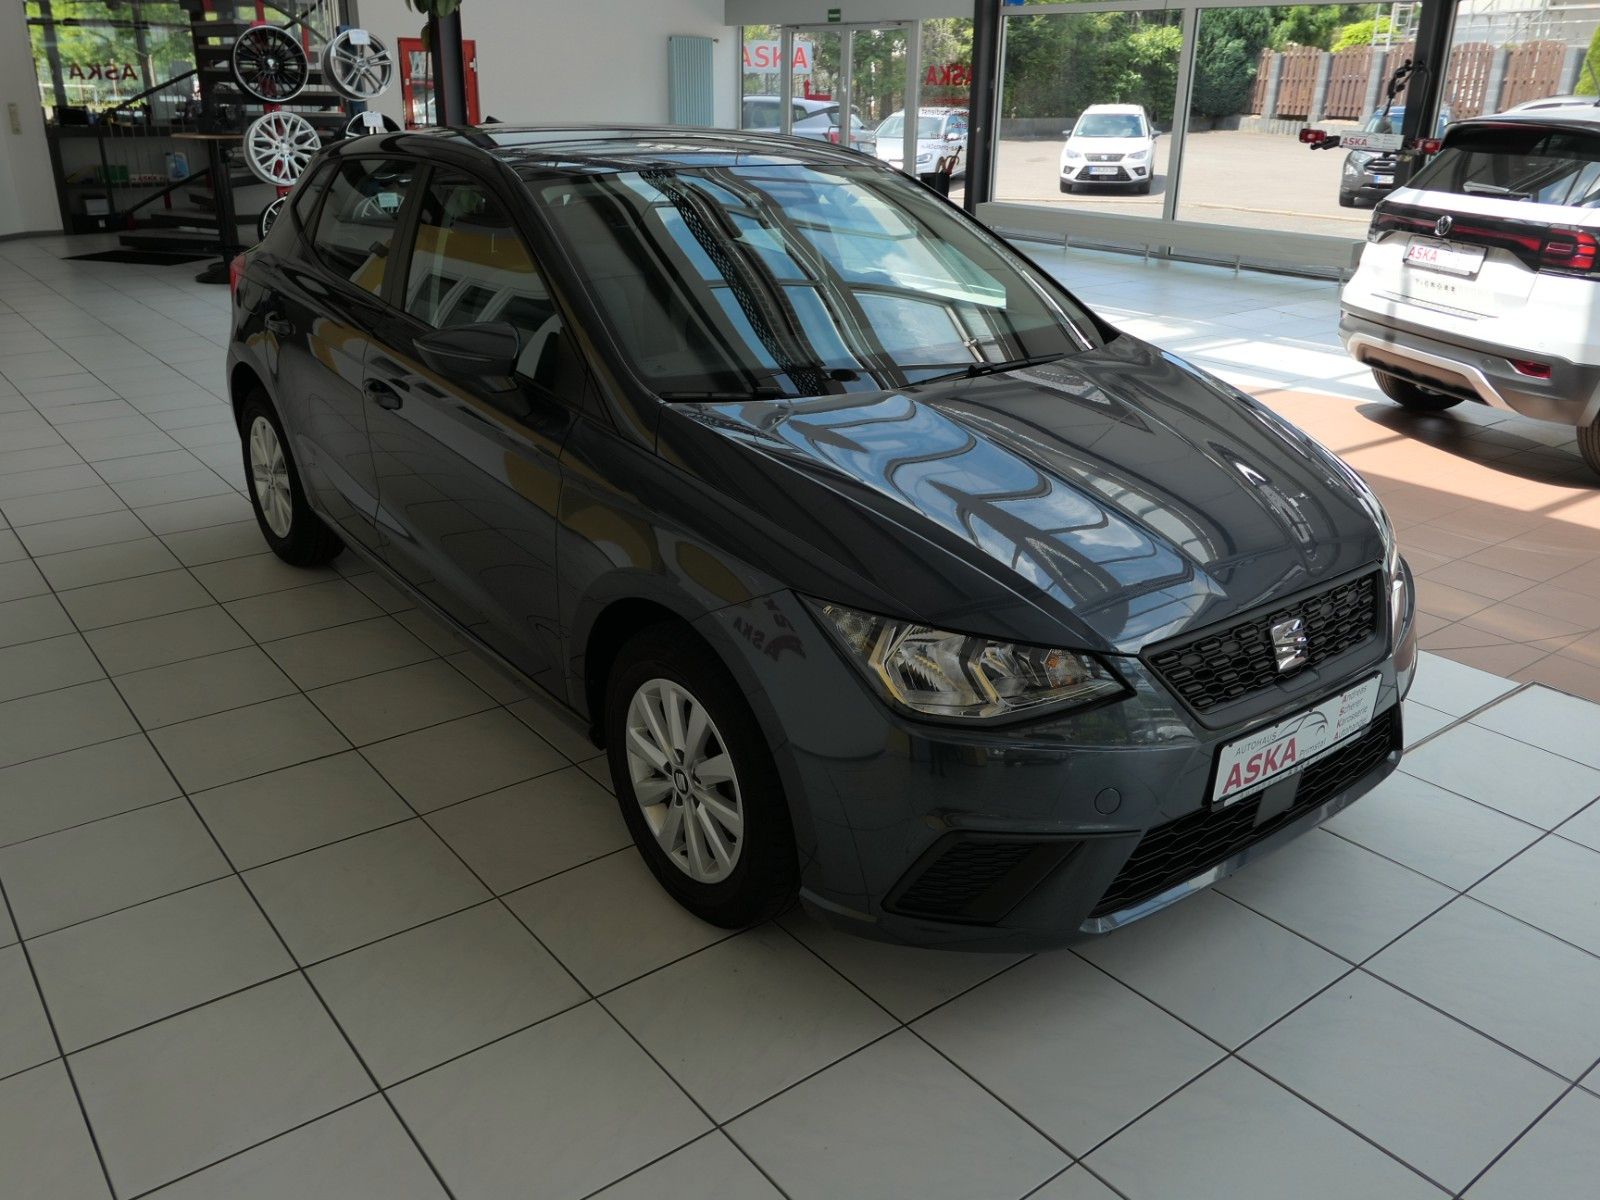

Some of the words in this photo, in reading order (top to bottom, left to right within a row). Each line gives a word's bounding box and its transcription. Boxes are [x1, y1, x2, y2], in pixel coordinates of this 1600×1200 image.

[1342, 137, 1367, 146] ASKA
[1409, 246, 1438, 263] ASKA
[1234, 732, 1277, 756] AUTOHAUS
[1222, 737, 1297, 795] ASKA
